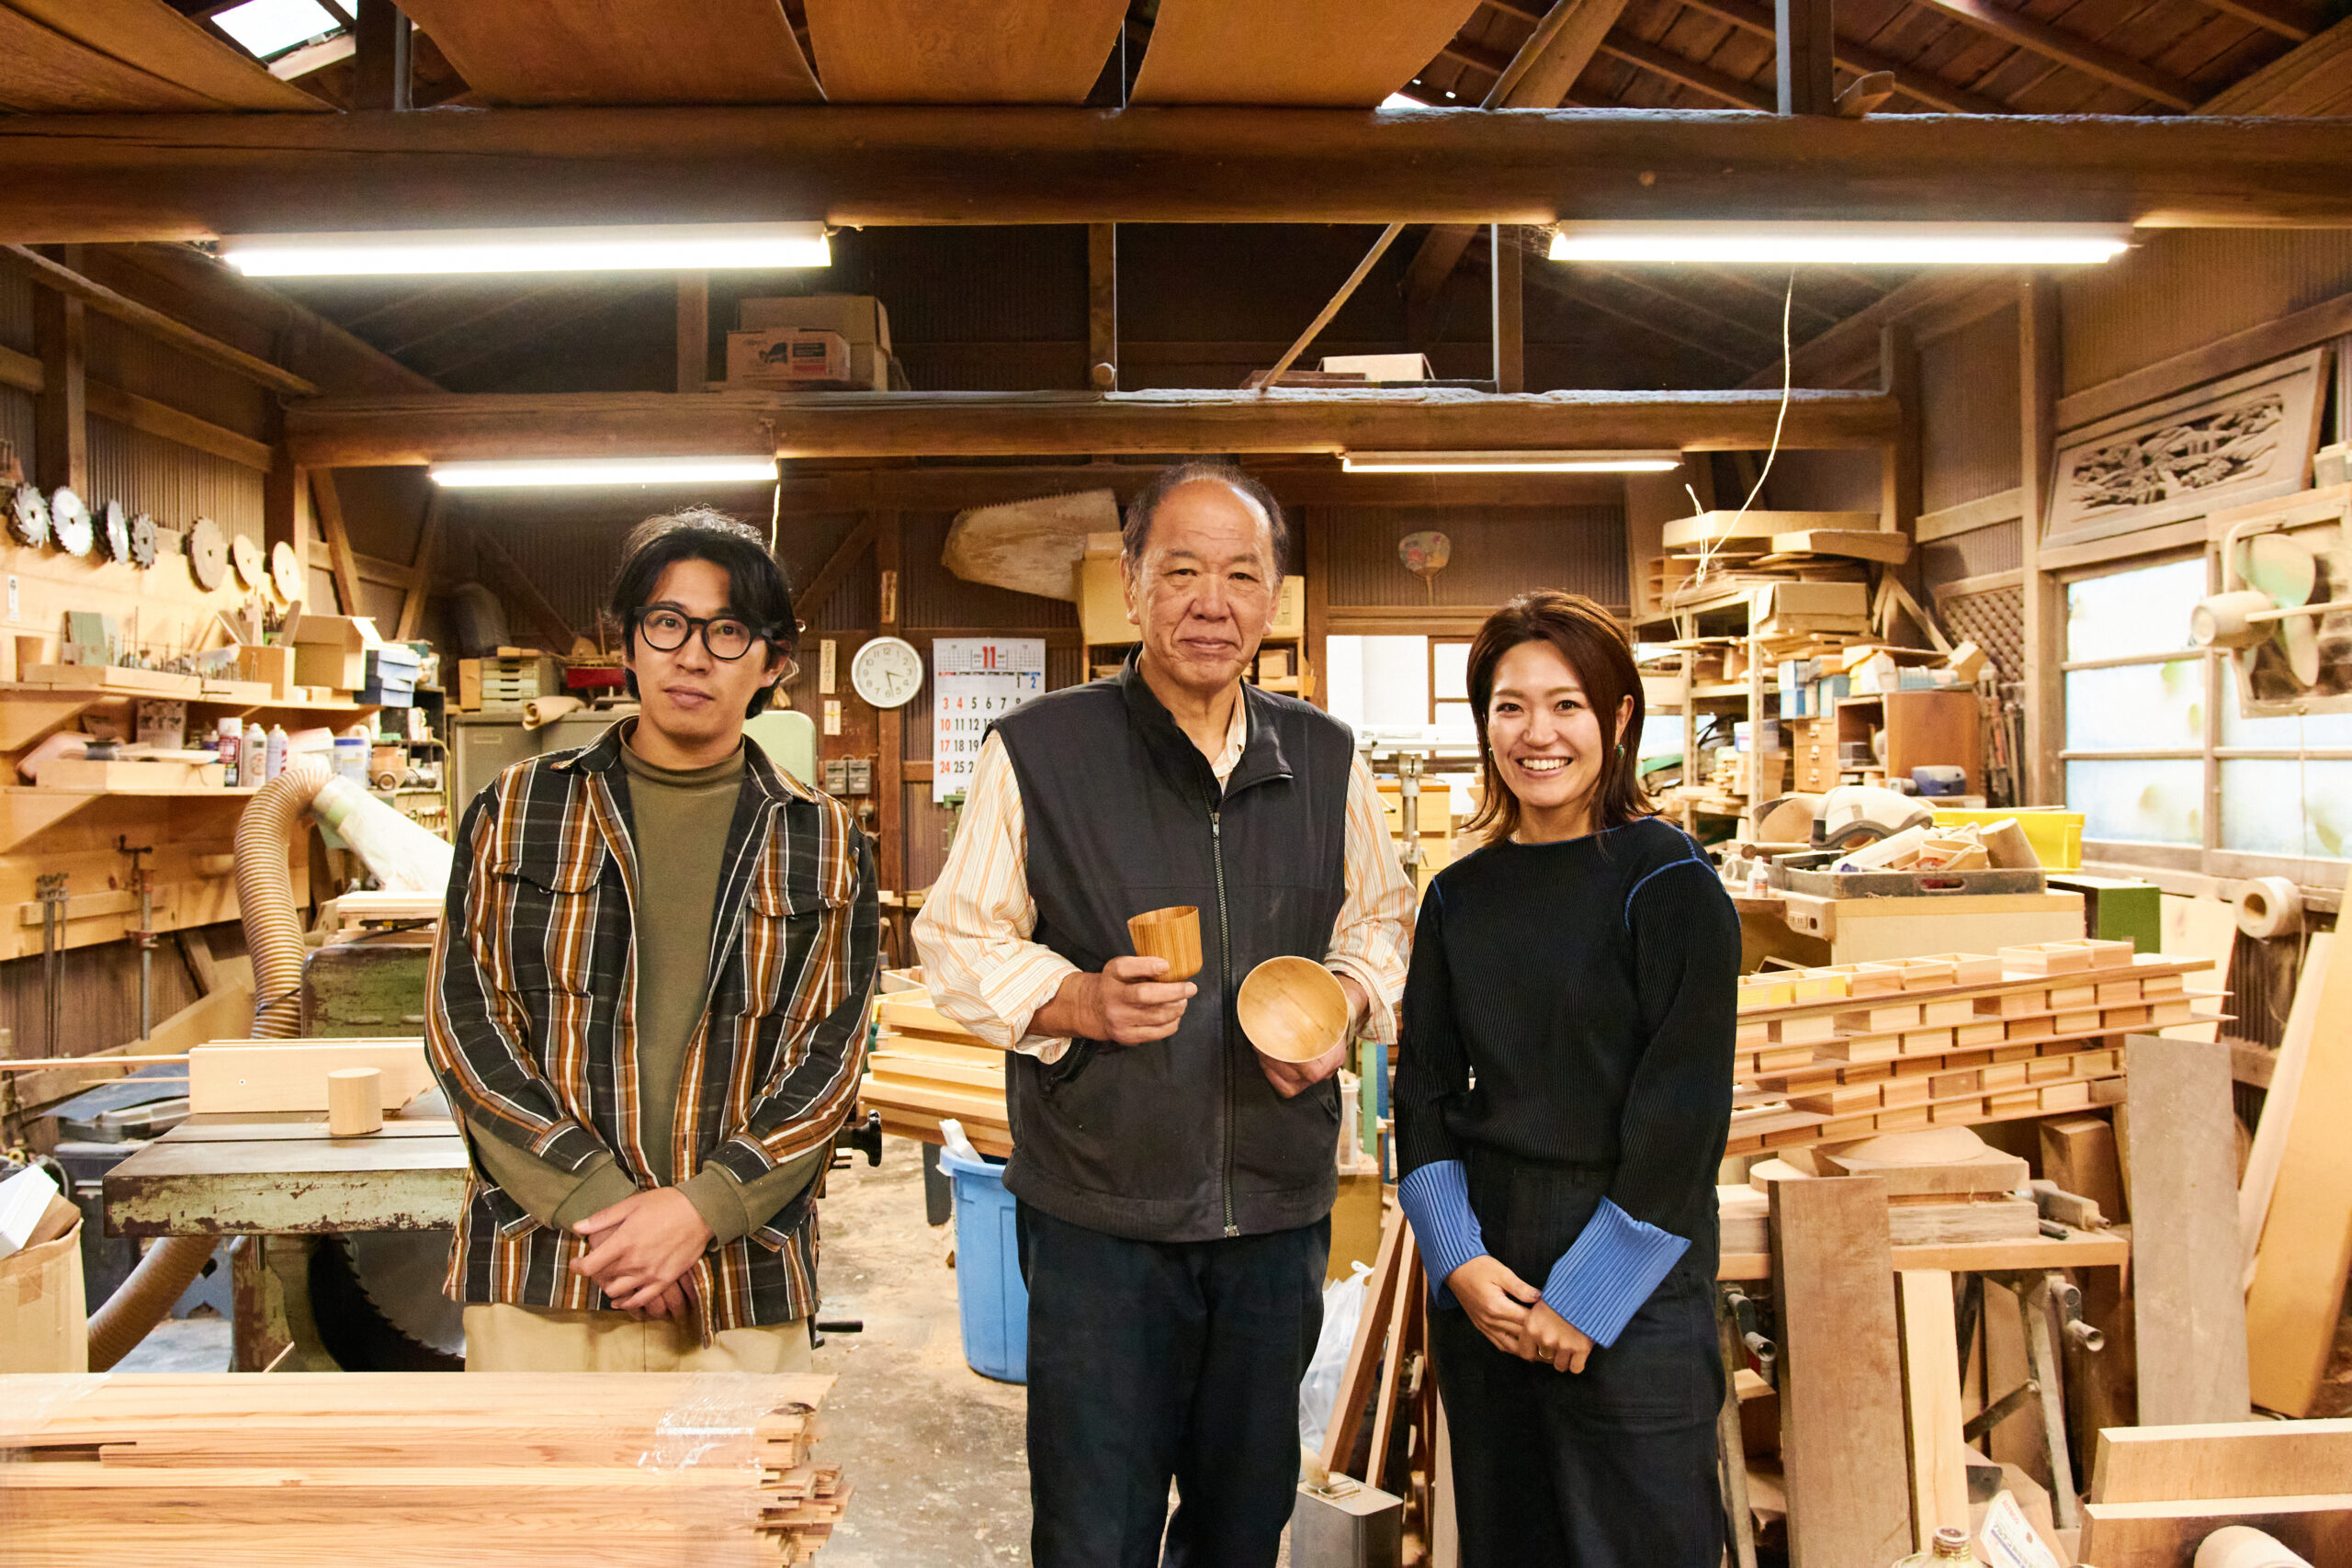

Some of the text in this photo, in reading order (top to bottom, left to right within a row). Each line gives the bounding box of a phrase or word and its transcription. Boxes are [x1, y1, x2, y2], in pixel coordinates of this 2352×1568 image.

[874, 650, 880, 659] 11
[883, 647, 890, 655] 12
[982, 646, 996, 669] 11
[1016, 676, 1036, 689] 1 2
[943, 697, 949, 710] 3
[957, 697, 963, 710] 4
[972, 697, 977, 709] 5
[986, 697, 992, 709] 6
[1001, 697, 1007, 710] 7
[941, 718, 951, 731] 10
[956, 718, 965, 730] 11
[969, 718, 979, 730] 12
[940, 739, 979, 752] 17 18 19
[940, 761, 950, 773] 24
[954, 761, 965, 773] 25
